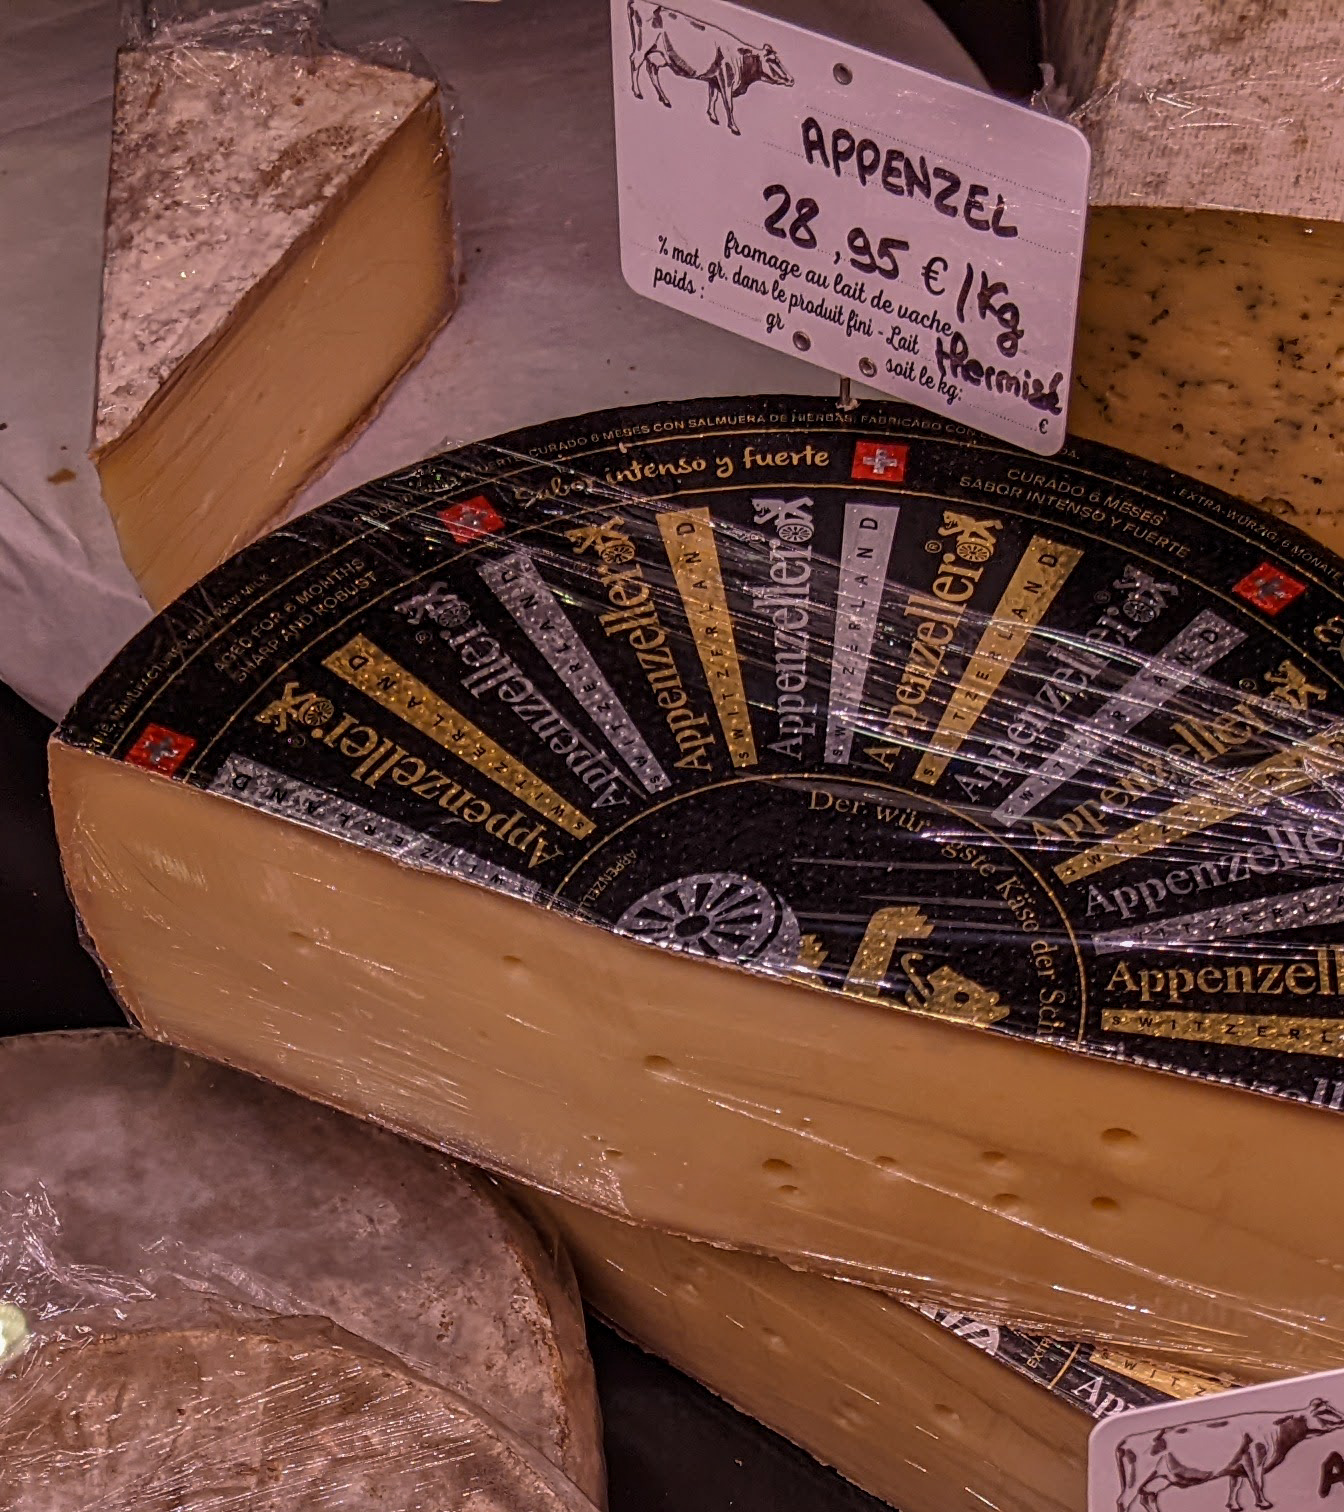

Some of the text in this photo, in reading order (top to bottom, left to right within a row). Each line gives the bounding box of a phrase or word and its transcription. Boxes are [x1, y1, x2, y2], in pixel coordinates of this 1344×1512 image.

[801, 116, 1019, 239] APPENZEL
[653, 266, 696, 295] poids
[766, 311, 785, 334] gr
[885, 358, 917, 382] soit
[919, 368, 935, 389] le
[671, 242, 704, 272] mat.
[707, 261, 729, 285] gr.
[732, 266, 769, 295] dans
[772, 285, 787, 304] le
[788, 290, 845, 326] produit
[846, 310, 874, 338] fini
[886, 326, 920, 356] Lait
[724, 231, 955, 338] fromage au lait de vache
[606, 445, 829, 483] intenso y fuerte
[653, 420, 684, 432] CON
[688, 414, 766, 428] SALMUERA
[959, 476, 1193, 559] SABOR INTENSO FUERTE
[1007, 468, 1164, 527] CURADO MESES
[316, 571, 378, 616] ROBUST
[754, 540, 816, 760] Appenzeller
[447, 616, 631, 808] Appenzeller
[599, 562, 714, 773] Appenzeller
[325, 711, 564, 870] Appenzeller
[808, 790, 864, 814] Der
[1030, 939, 1057, 980] der
